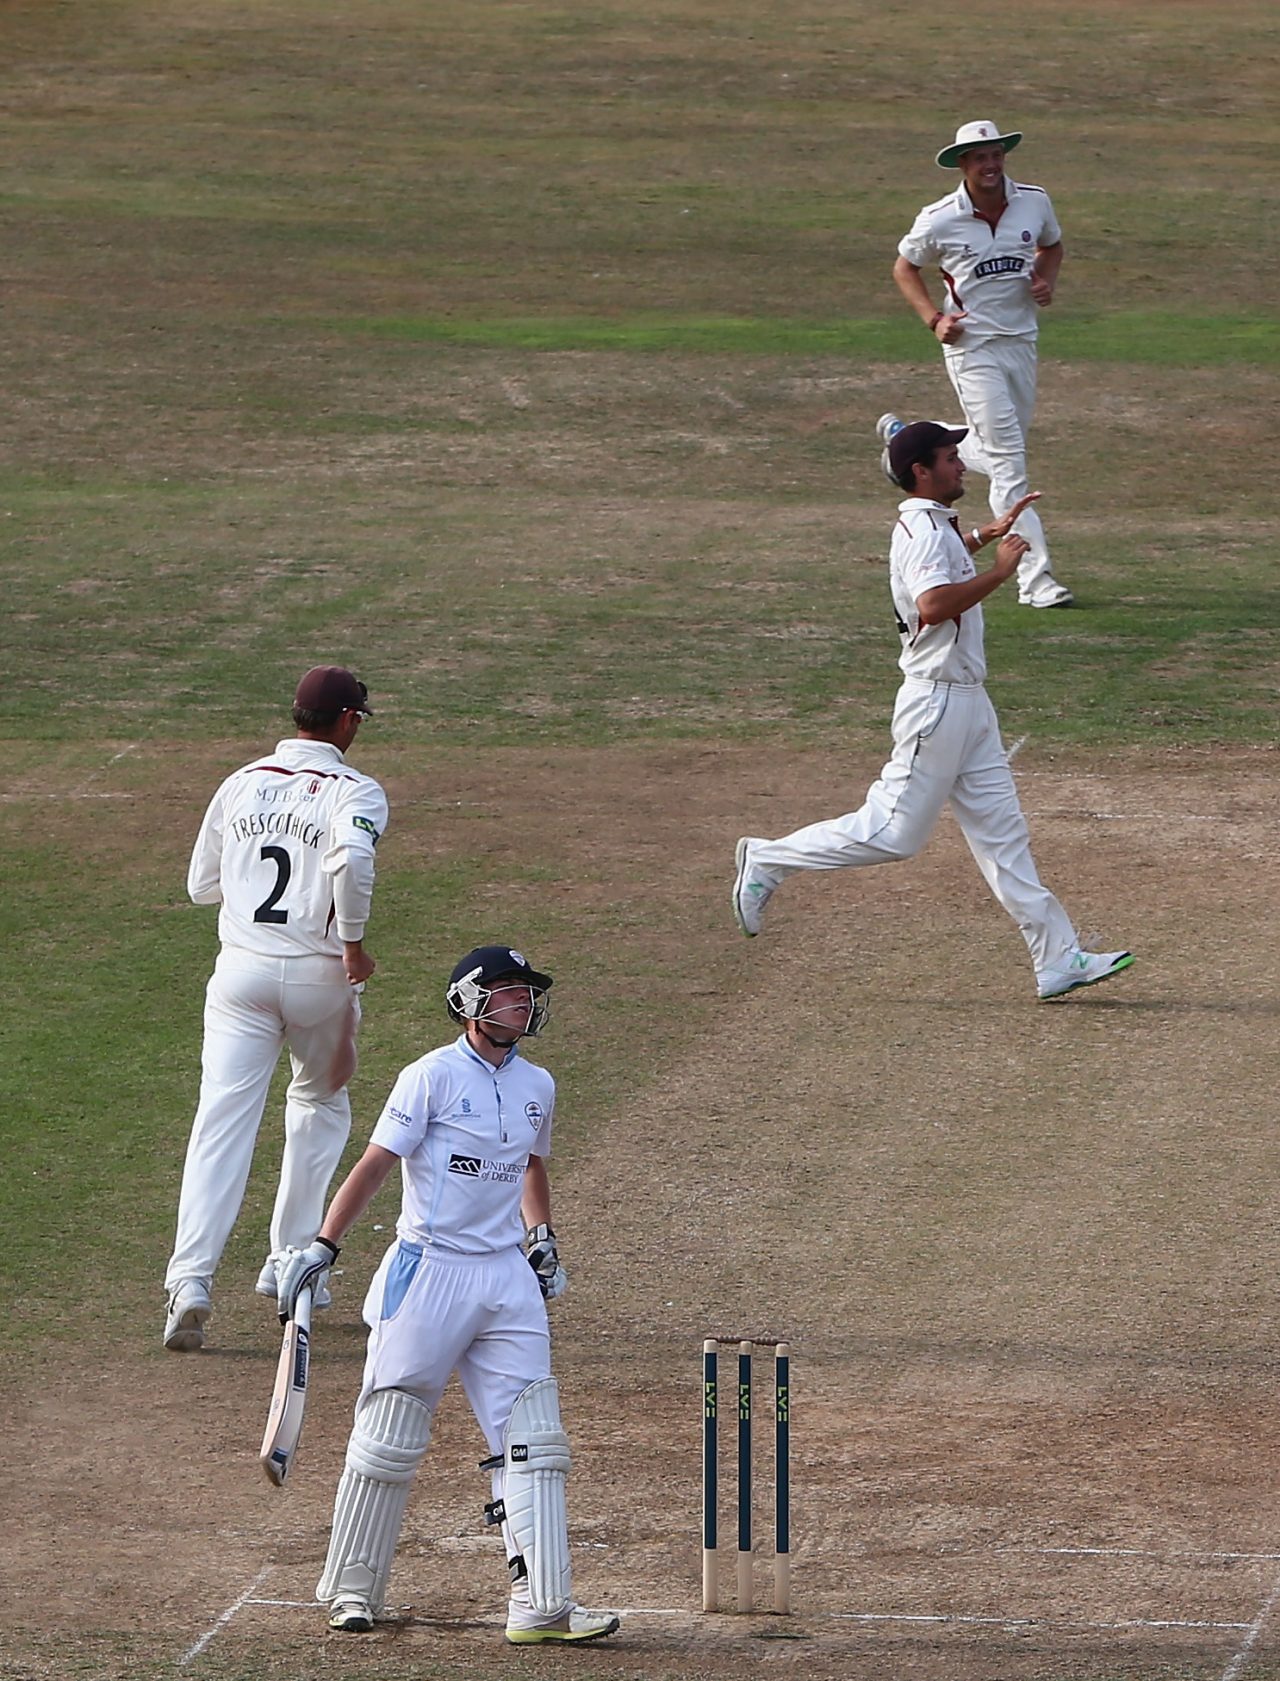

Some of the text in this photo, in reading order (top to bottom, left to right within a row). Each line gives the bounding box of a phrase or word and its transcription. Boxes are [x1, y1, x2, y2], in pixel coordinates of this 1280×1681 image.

[232, 812, 325, 849] TRESCOTHICK
[253, 846, 291, 925] 2
[481, 1171, 519, 1183] of DERBY
[705, 1382, 716, 1418] LV=
[739, 1384, 750, 1420] LV=
[777, 1386, 788, 1422] LV=
